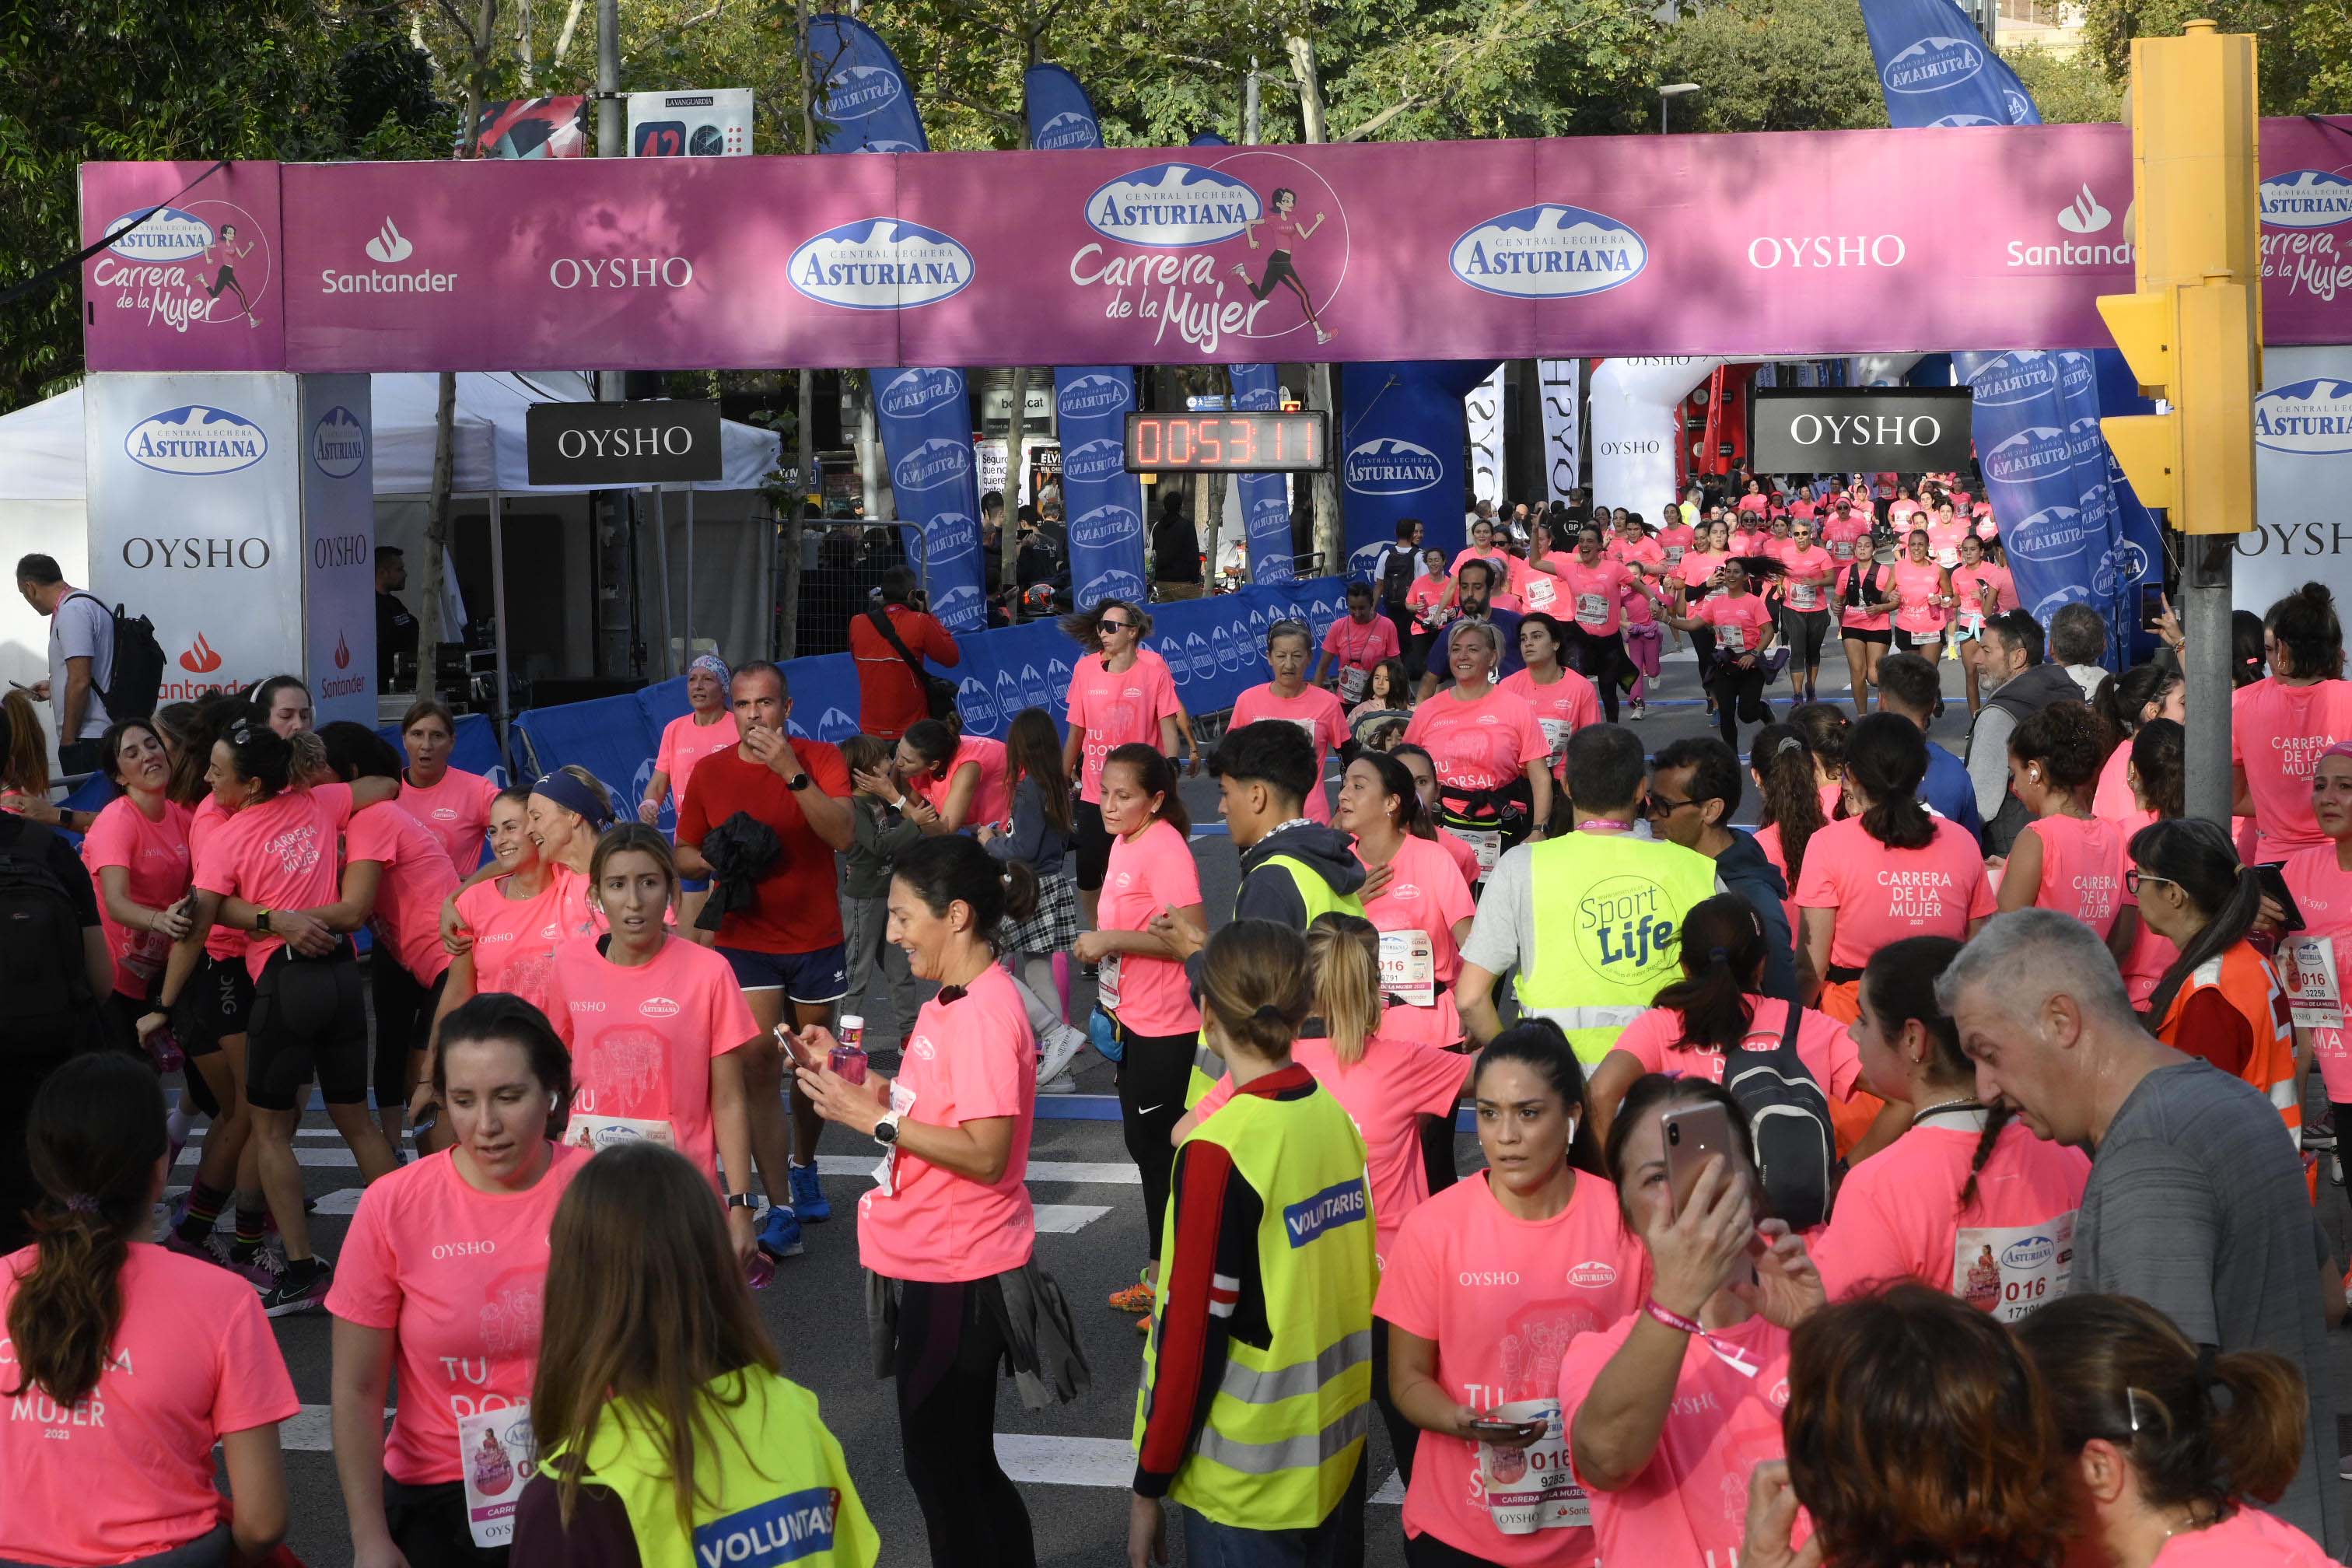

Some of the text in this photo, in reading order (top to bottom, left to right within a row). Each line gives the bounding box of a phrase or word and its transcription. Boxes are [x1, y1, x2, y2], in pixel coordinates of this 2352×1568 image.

[1125, 191, 1243, 201] CENTRAL LECHERA
[1098, 194, 1247, 226] ASTURIANA
[1496, 235, 1626, 247] CENTRAL LECHERA
[1748, 234, 1906, 269] OYSHO
[2260, 233, 2334, 255] arrera
[831, 248, 953, 259] CENTRAL LECHERA
[1465, 240, 1633, 275] ASTURIANA
[2007, 240, 2136, 266] Santand
[94, 258, 187, 287] Carrera
[549, 256, 693, 289] OYSHO
[802, 253, 960, 286] ASTURIANA
[1069, 243, 1216, 287] Carrera
[2278, 256, 2293, 277] la
[322, 268, 457, 293] Santander
[2289, 251, 2352, 302] Muje
[117, 288, 150, 309] de la
[148, 285, 221, 333] Mujer
[1105, 288, 1158, 318] de la
[1153, 282, 1270, 354] Mujer
[1790, 414, 1941, 446] OYSHO
[2256, 408, 2352, 436] ASTURI
[137, 432, 257, 459] ASTURIANA
[317, 432, 362, 460] ASTURIANA
[558, 425, 693, 459] OYSHO
[1138, 418, 1313, 464] 00:53:11
[1601, 439, 1660, 456] OYSHO
[1348, 461, 1436, 482] ASTURIANA
[2233, 523, 2352, 557] OYSH
[122, 537, 271, 569] OYSHO
[314, 534, 367, 571] OYSHO
[320, 676, 366, 700] Santander
[1087, 729, 1103, 740] TU
[2271, 733, 2336, 750] CARRERA
[2284, 748, 2322, 762] DE LA
[2282, 761, 2319, 775] MUJE
[264, 823, 317, 854] CARRERA
[280, 839, 314, 862] DE LA
[1877, 870, 1952, 887] CARRERA
[2072, 876, 2118, 891] CARRERA
[1892, 887, 1940, 902] DE LA
[2081, 890, 2109, 904] DE LA
[1580, 885, 1658, 929] Sport
[1888, 902, 1942, 917] MUJER
[478, 932, 513, 946] OYSHO
[1597, 915, 1673, 968] Life
[2301, 972, 2326, 986] 016
[2305, 989, 2326, 998] 32256
[569, 1001, 606, 1012] OYSHO
[432, 1240, 496, 1260] OYSHO
[2006, 1248, 2051, 1263] ASTURIANA
[1459, 1271, 1520, 1287] OYSHO
[1571, 1272, 1613, 1283] ASTURIANA
[2005, 1276, 2046, 1301] 016
[439, 1356, 487, 1385] TU
[11, 1395, 106, 1428] MUJER
[44, 1428, 70, 1440] 2023
[1531, 1449, 1571, 1470] 016
[1501, 1494, 1540, 1504] CARRERA
[1559, 1489, 1587, 1498] MUJER
[487, 1505, 516, 1517] CARRE
[1500, 1511, 1540, 1524] OYSHO
[485, 1524, 515, 1538] OYS
